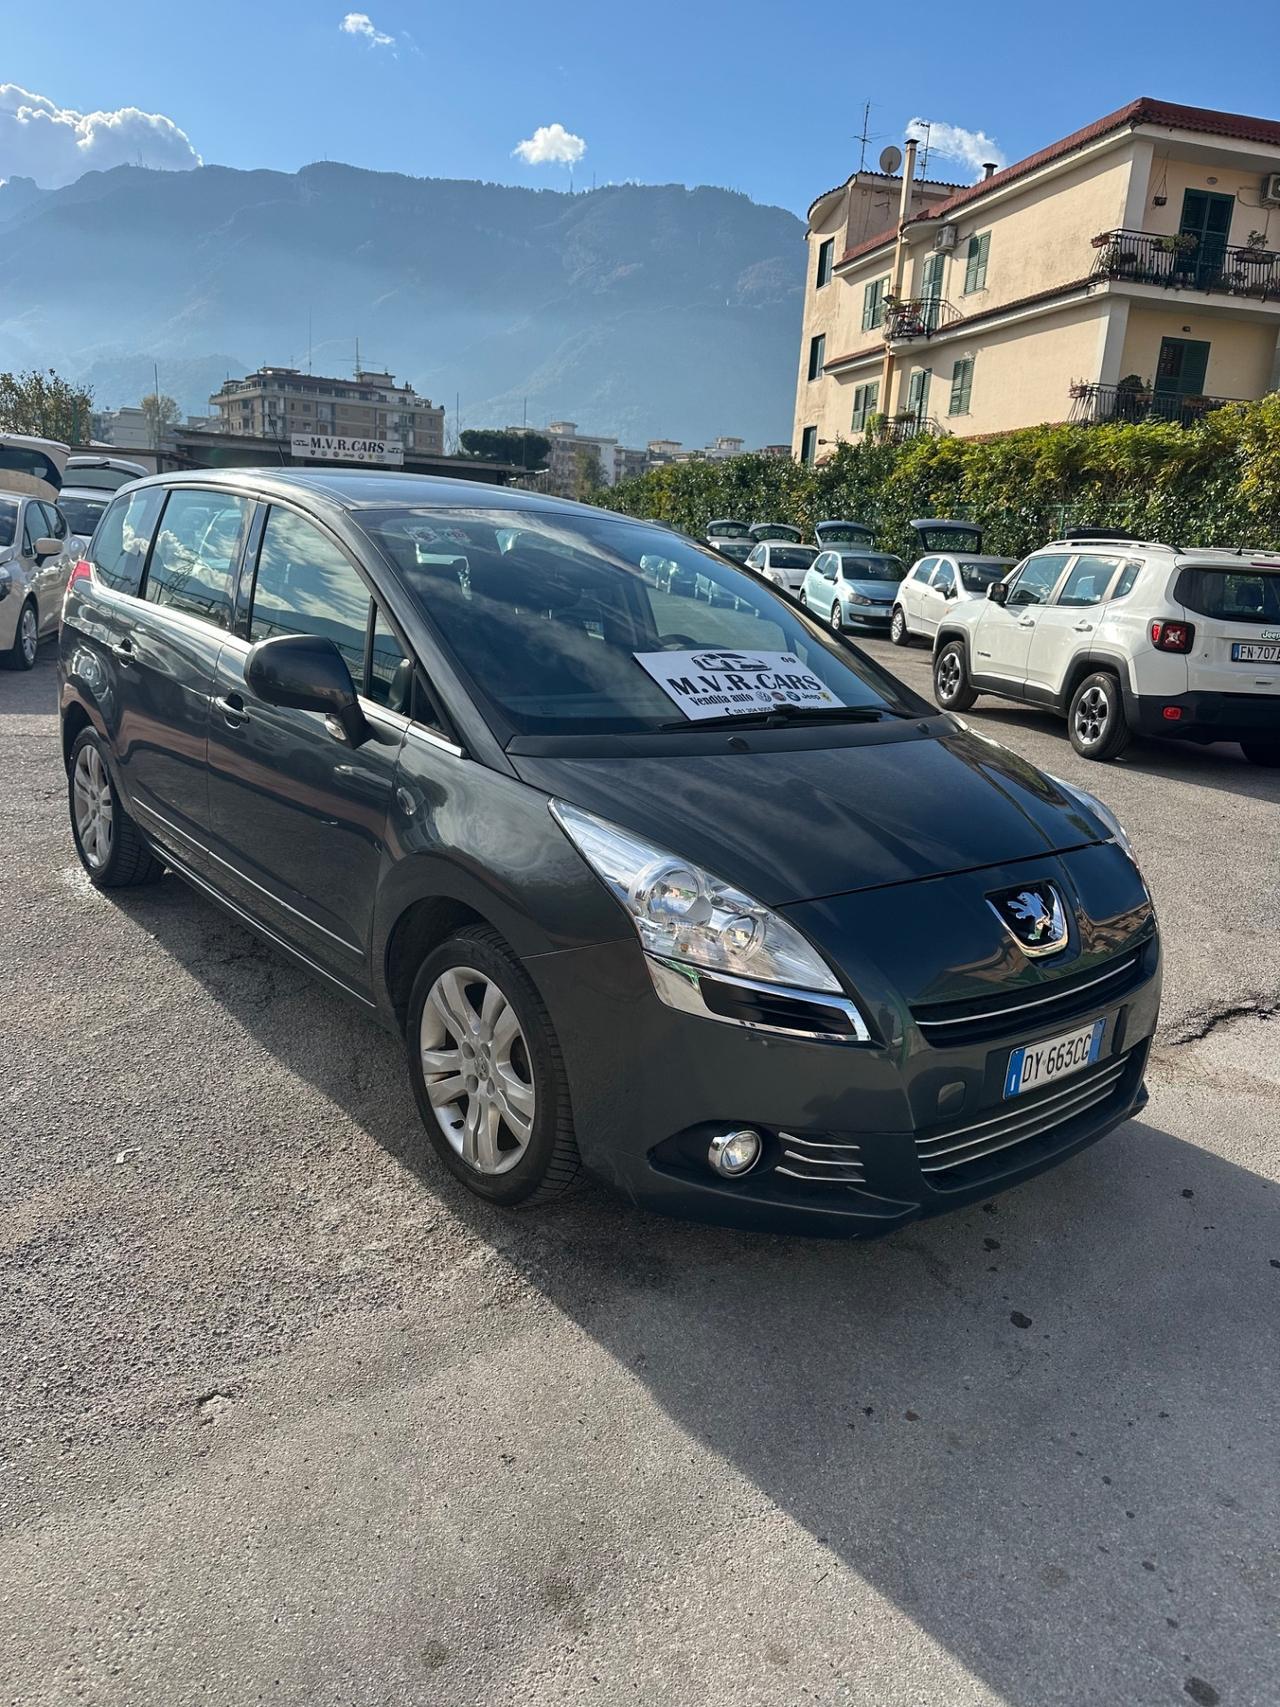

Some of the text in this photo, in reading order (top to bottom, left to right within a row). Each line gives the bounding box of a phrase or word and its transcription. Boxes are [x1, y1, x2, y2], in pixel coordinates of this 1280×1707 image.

[311, 437, 385, 453] M.V.R.CARS
[666, 673, 822, 696] M.V.R.CARS
[689, 695, 731, 707] Vendita
[732, 693, 754, 703] auto
[1022, 1050, 1044, 1083] DY
